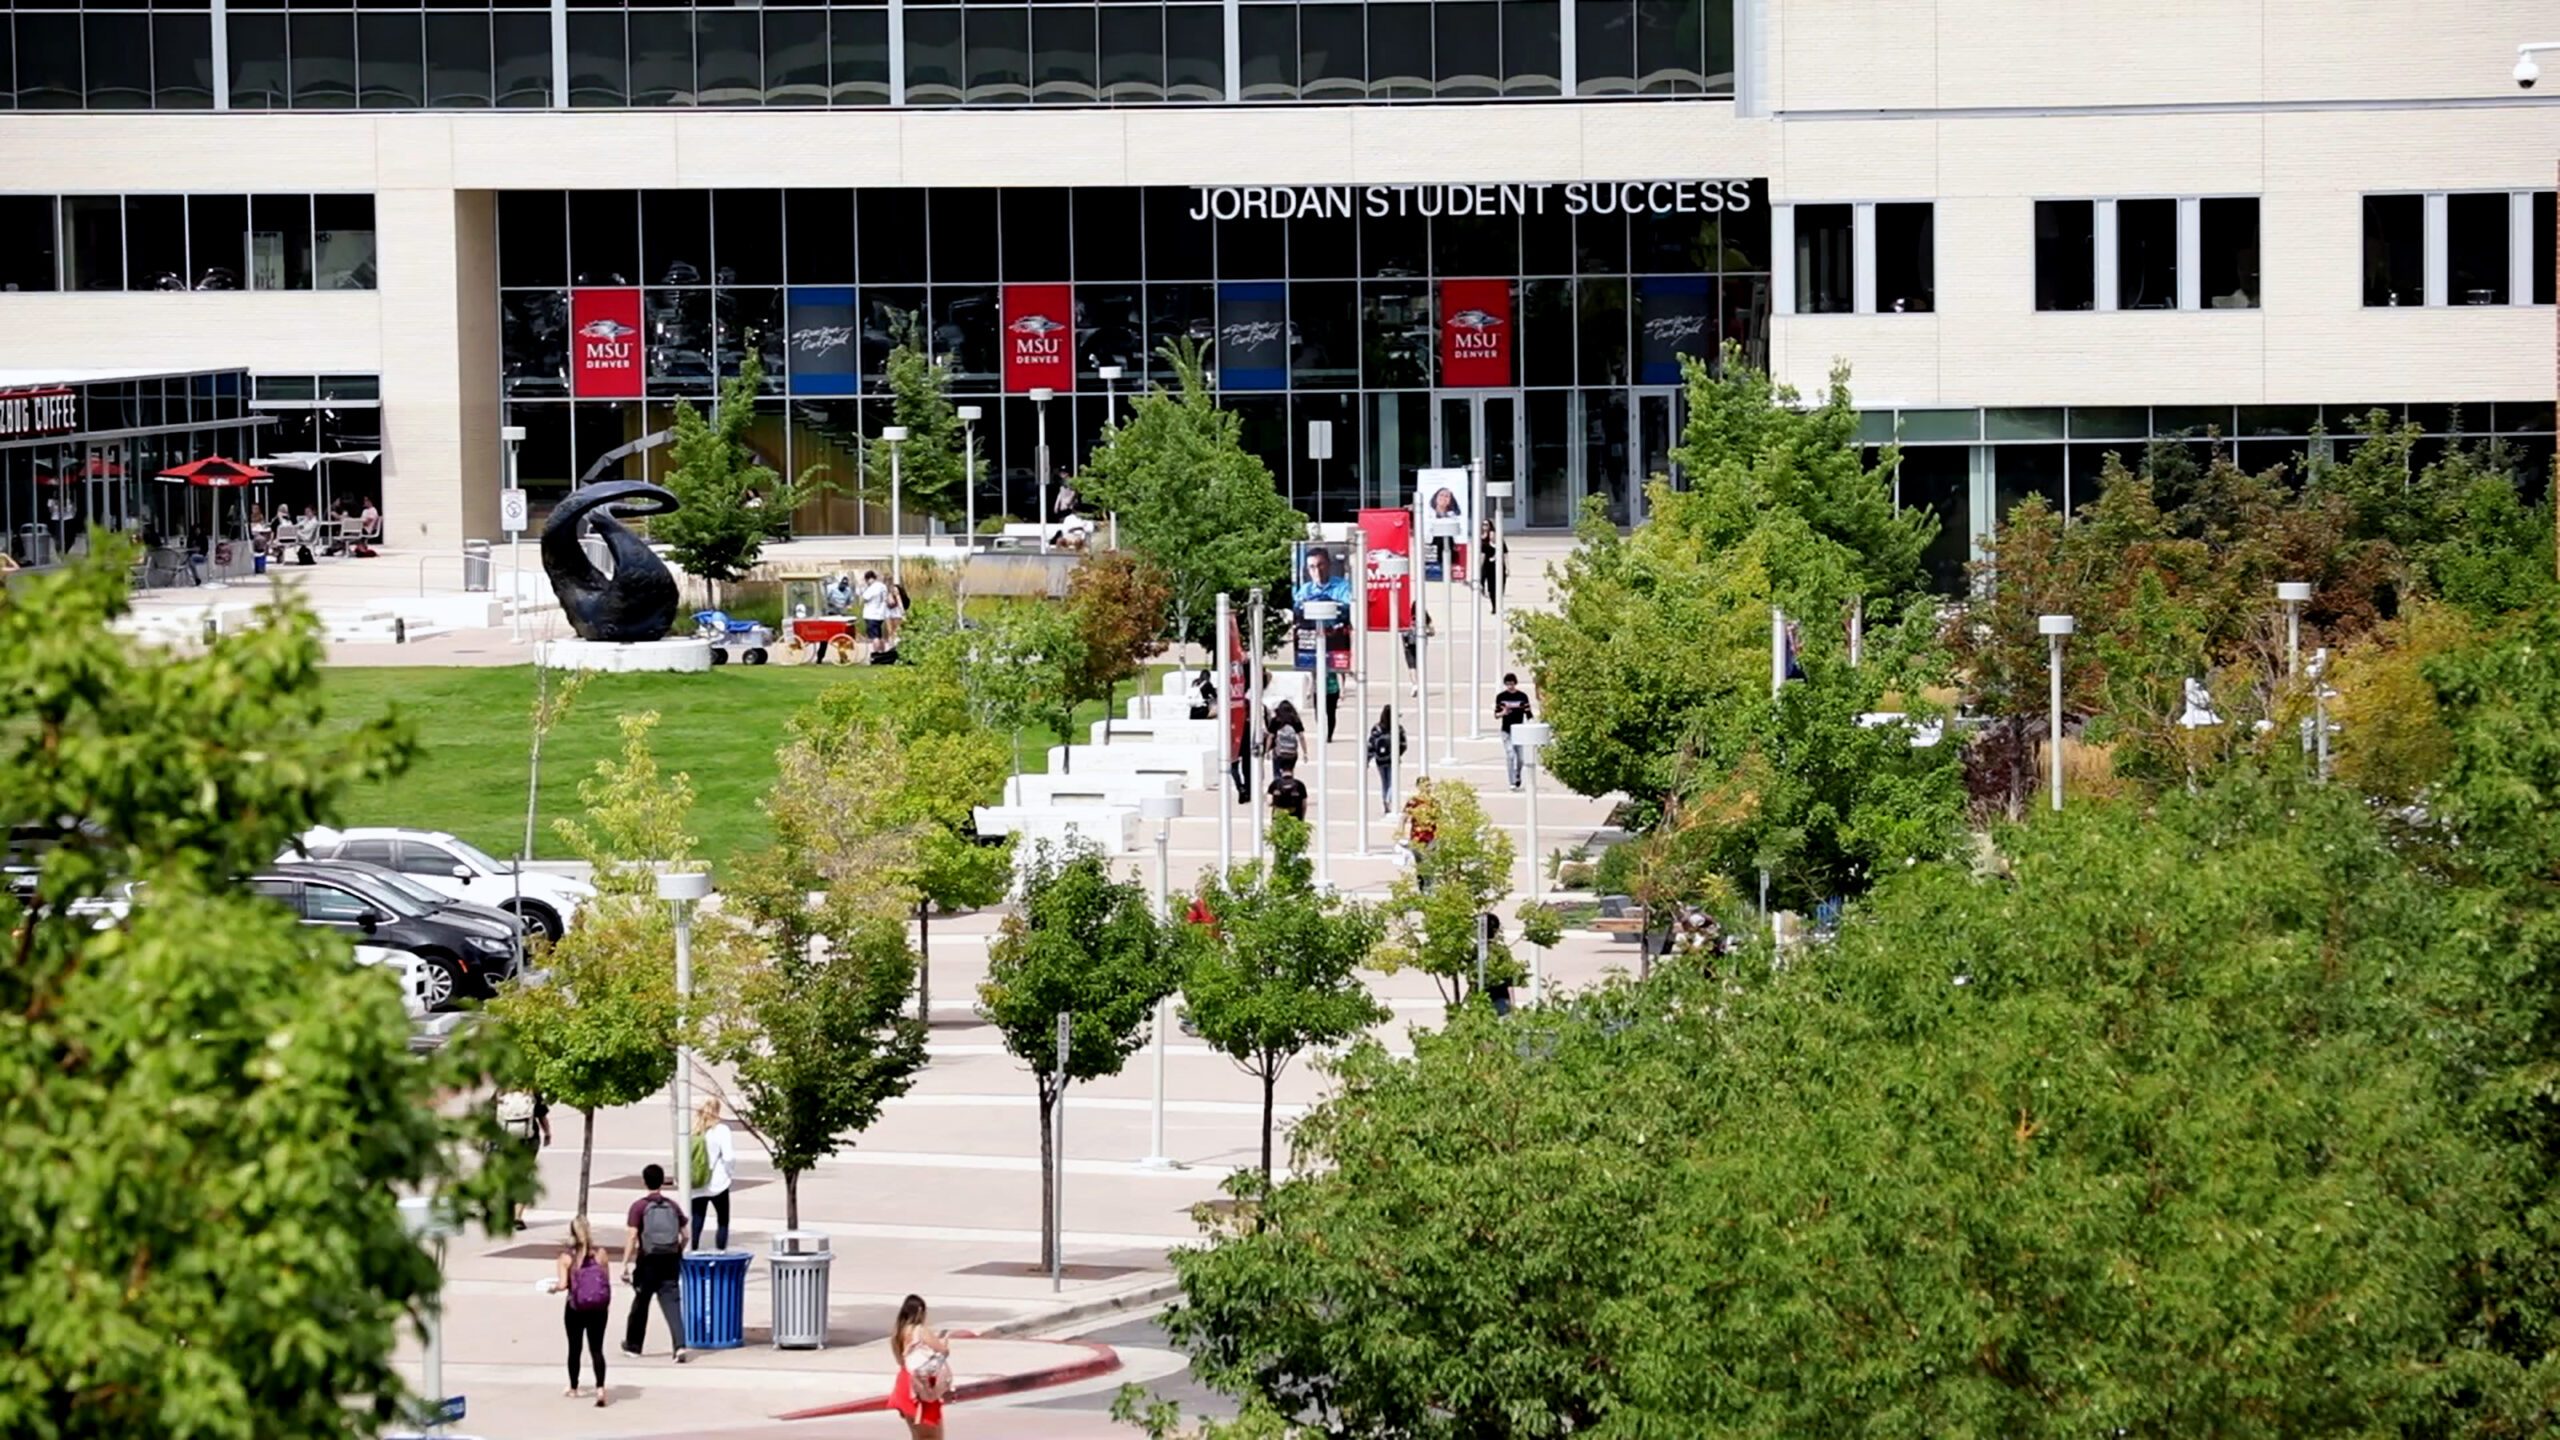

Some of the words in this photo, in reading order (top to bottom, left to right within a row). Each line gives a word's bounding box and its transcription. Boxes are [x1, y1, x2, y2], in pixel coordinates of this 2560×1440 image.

[1190, 186, 1351, 221] JORDAN
[1366, 184, 1552, 217] STUDENT
[1564, 181, 1751, 214] SUCCESS
[1017, 338, 1058, 354] MSU
[1455, 333, 1497, 348] MSU
[587, 343, 629, 358] MSU
[1454, 350, 1498, 359] DENVER
[586, 359, 630, 369] DENVER
[1016, 355, 1060, 364] DENVER
[34, 394, 77, 432] COFFEE
